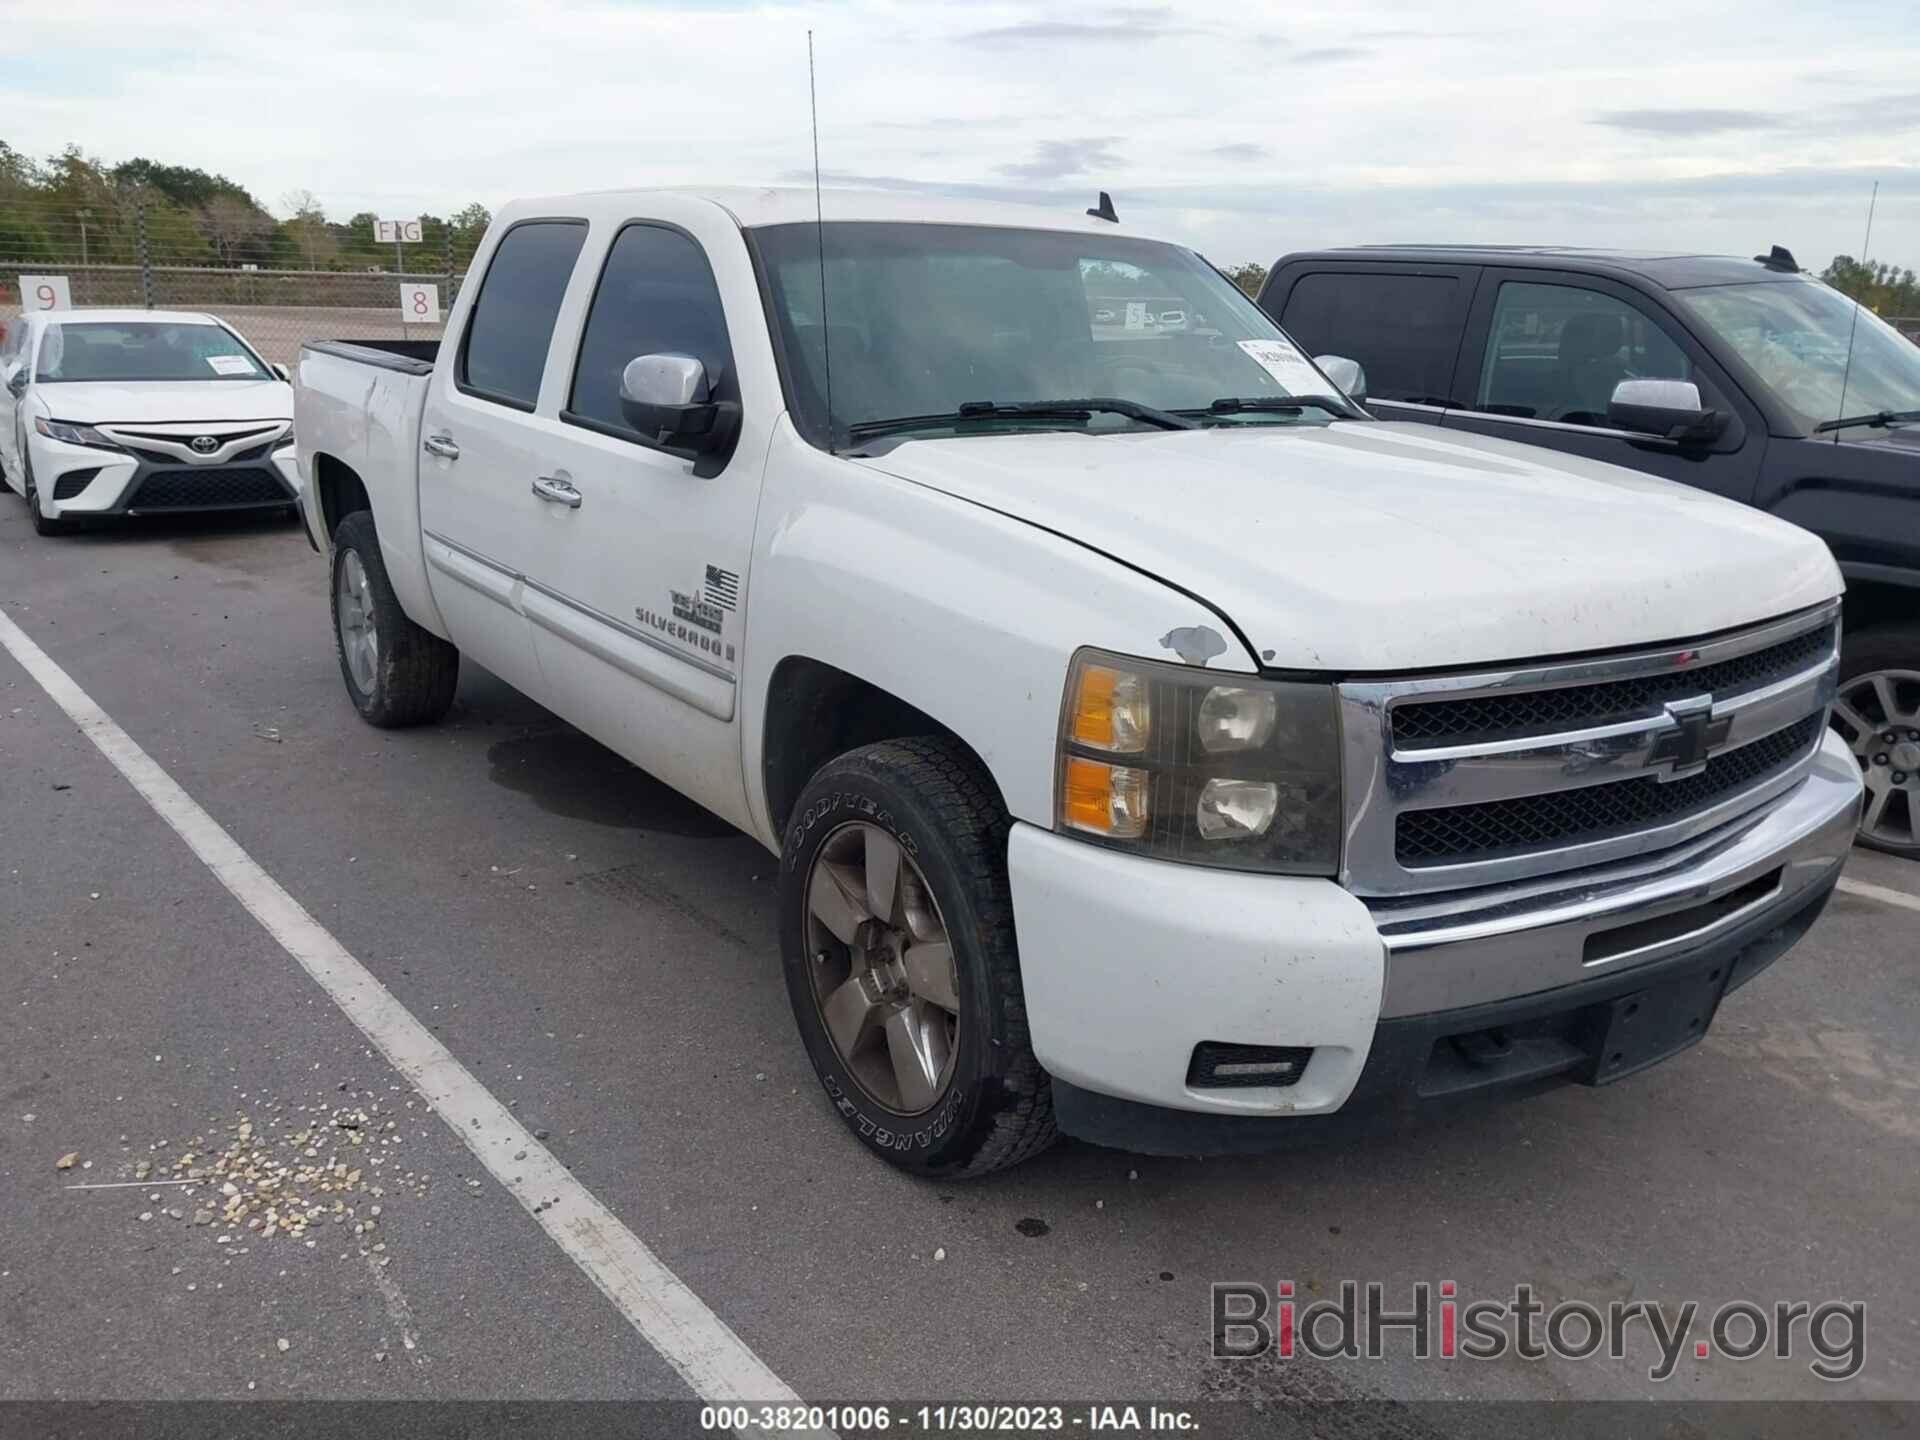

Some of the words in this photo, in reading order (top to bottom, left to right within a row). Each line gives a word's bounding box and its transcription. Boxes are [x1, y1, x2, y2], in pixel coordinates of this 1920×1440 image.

[36, 285, 56, 311] 9
[413, 291, 428, 315] 8
[635, 606, 722, 657] SILVERADO
[823, 1074, 964, 1151] WRANGLER
